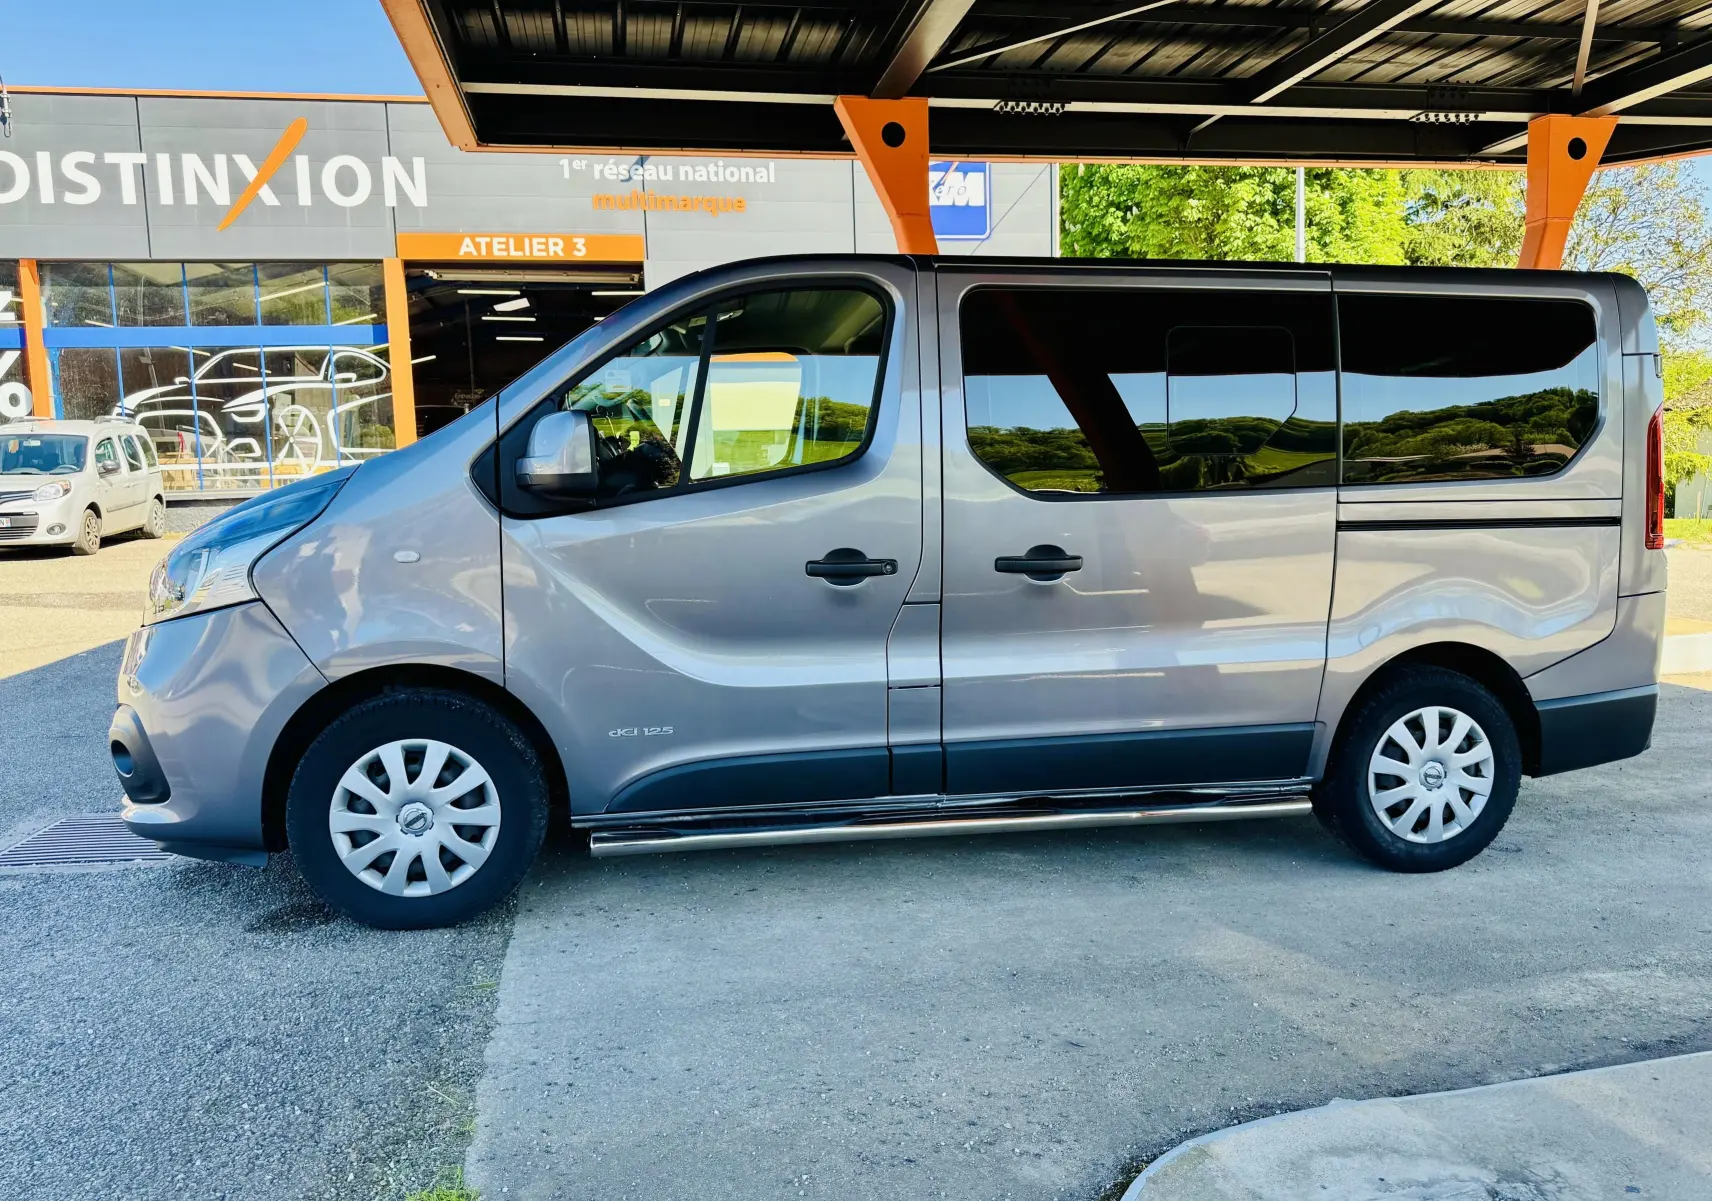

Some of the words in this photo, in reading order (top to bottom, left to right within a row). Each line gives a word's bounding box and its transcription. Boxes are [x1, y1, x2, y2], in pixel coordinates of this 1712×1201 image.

[0, 117, 429, 232] DISTINXION
[559, 158, 588, 179] 1er
[593, 158, 673, 181] réseau
[679, 160, 776, 183] national
[592, 189, 746, 217] multimarque
[458, 236, 565, 257] ATELIER
[572, 237, 587, 257] 3
[643, 726, 674, 736] 125
